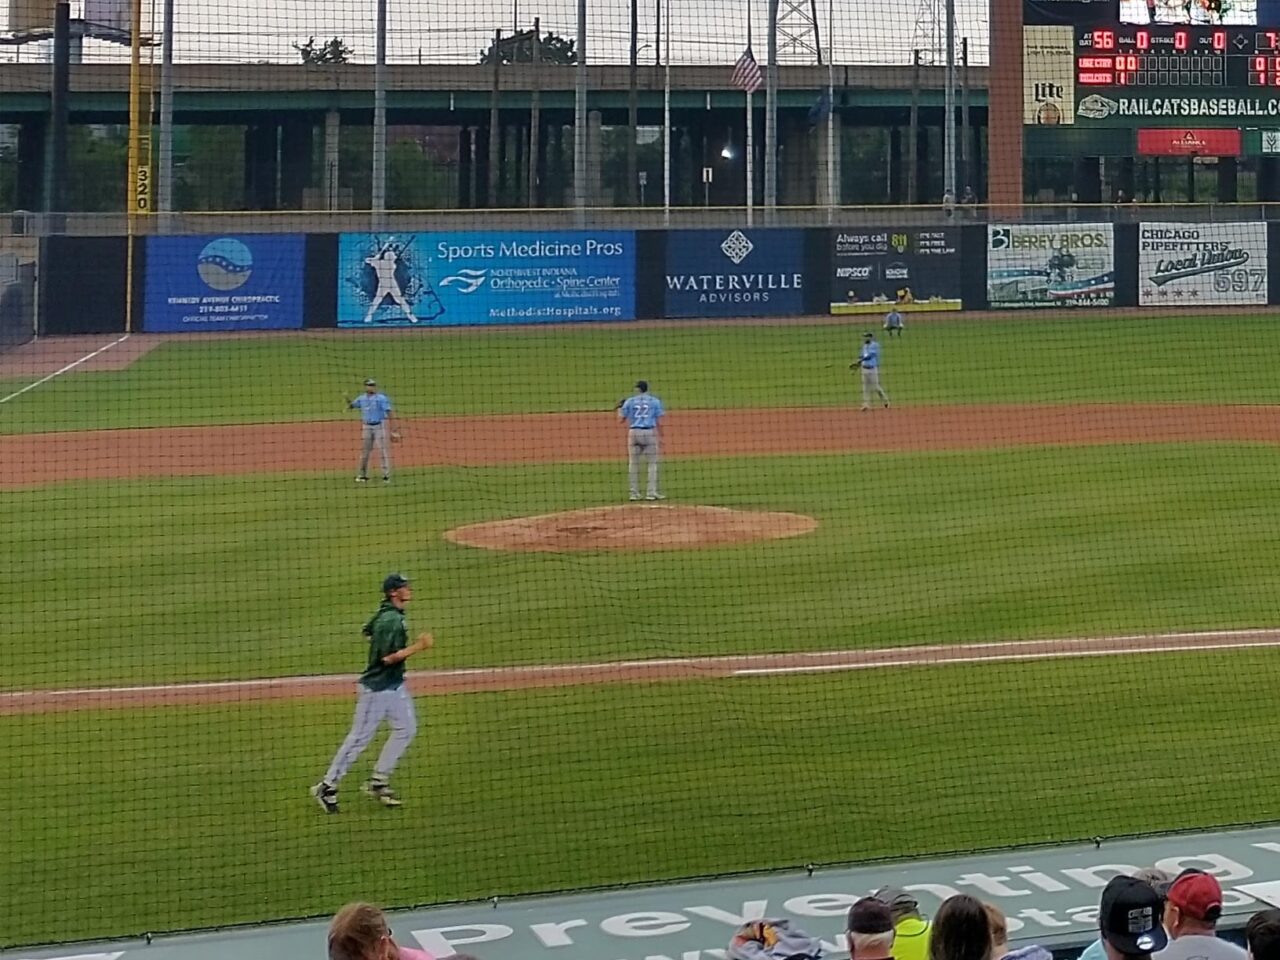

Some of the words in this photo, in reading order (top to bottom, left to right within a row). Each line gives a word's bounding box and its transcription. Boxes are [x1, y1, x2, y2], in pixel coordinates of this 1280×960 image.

[1093, 31, 1113, 48] 56
[1136, 31, 1148, 48] 0
[1175, 31, 1186, 49] 0
[1214, 32, 1225, 49] 0
[1034, 82, 1064, 103] Lite
[836, 234, 869, 244] Always
[871, 233, 888, 242] call
[1142, 230, 1200, 240] CHICAGO
[438, 242, 495, 262] Sports
[500, 240, 581, 257] Medicine
[586, 240, 623, 256] Pros
[861, 244, 874, 252] you
[1155, 252, 1198, 274] Local
[1200, 248, 1242, 267] Union
[836, 267, 869, 277] NIPSCO
[490, 277, 550, 292] Orthopedic
[556, 276, 586, 290] Spine
[586, 276, 620, 287] Center
[666, 273, 802, 291] WATERVILLE
[700, 292, 770, 303] ADVISORS
[489, 306, 621, 318] MethodistHospitals.org
[634, 404, 648, 418] 22
